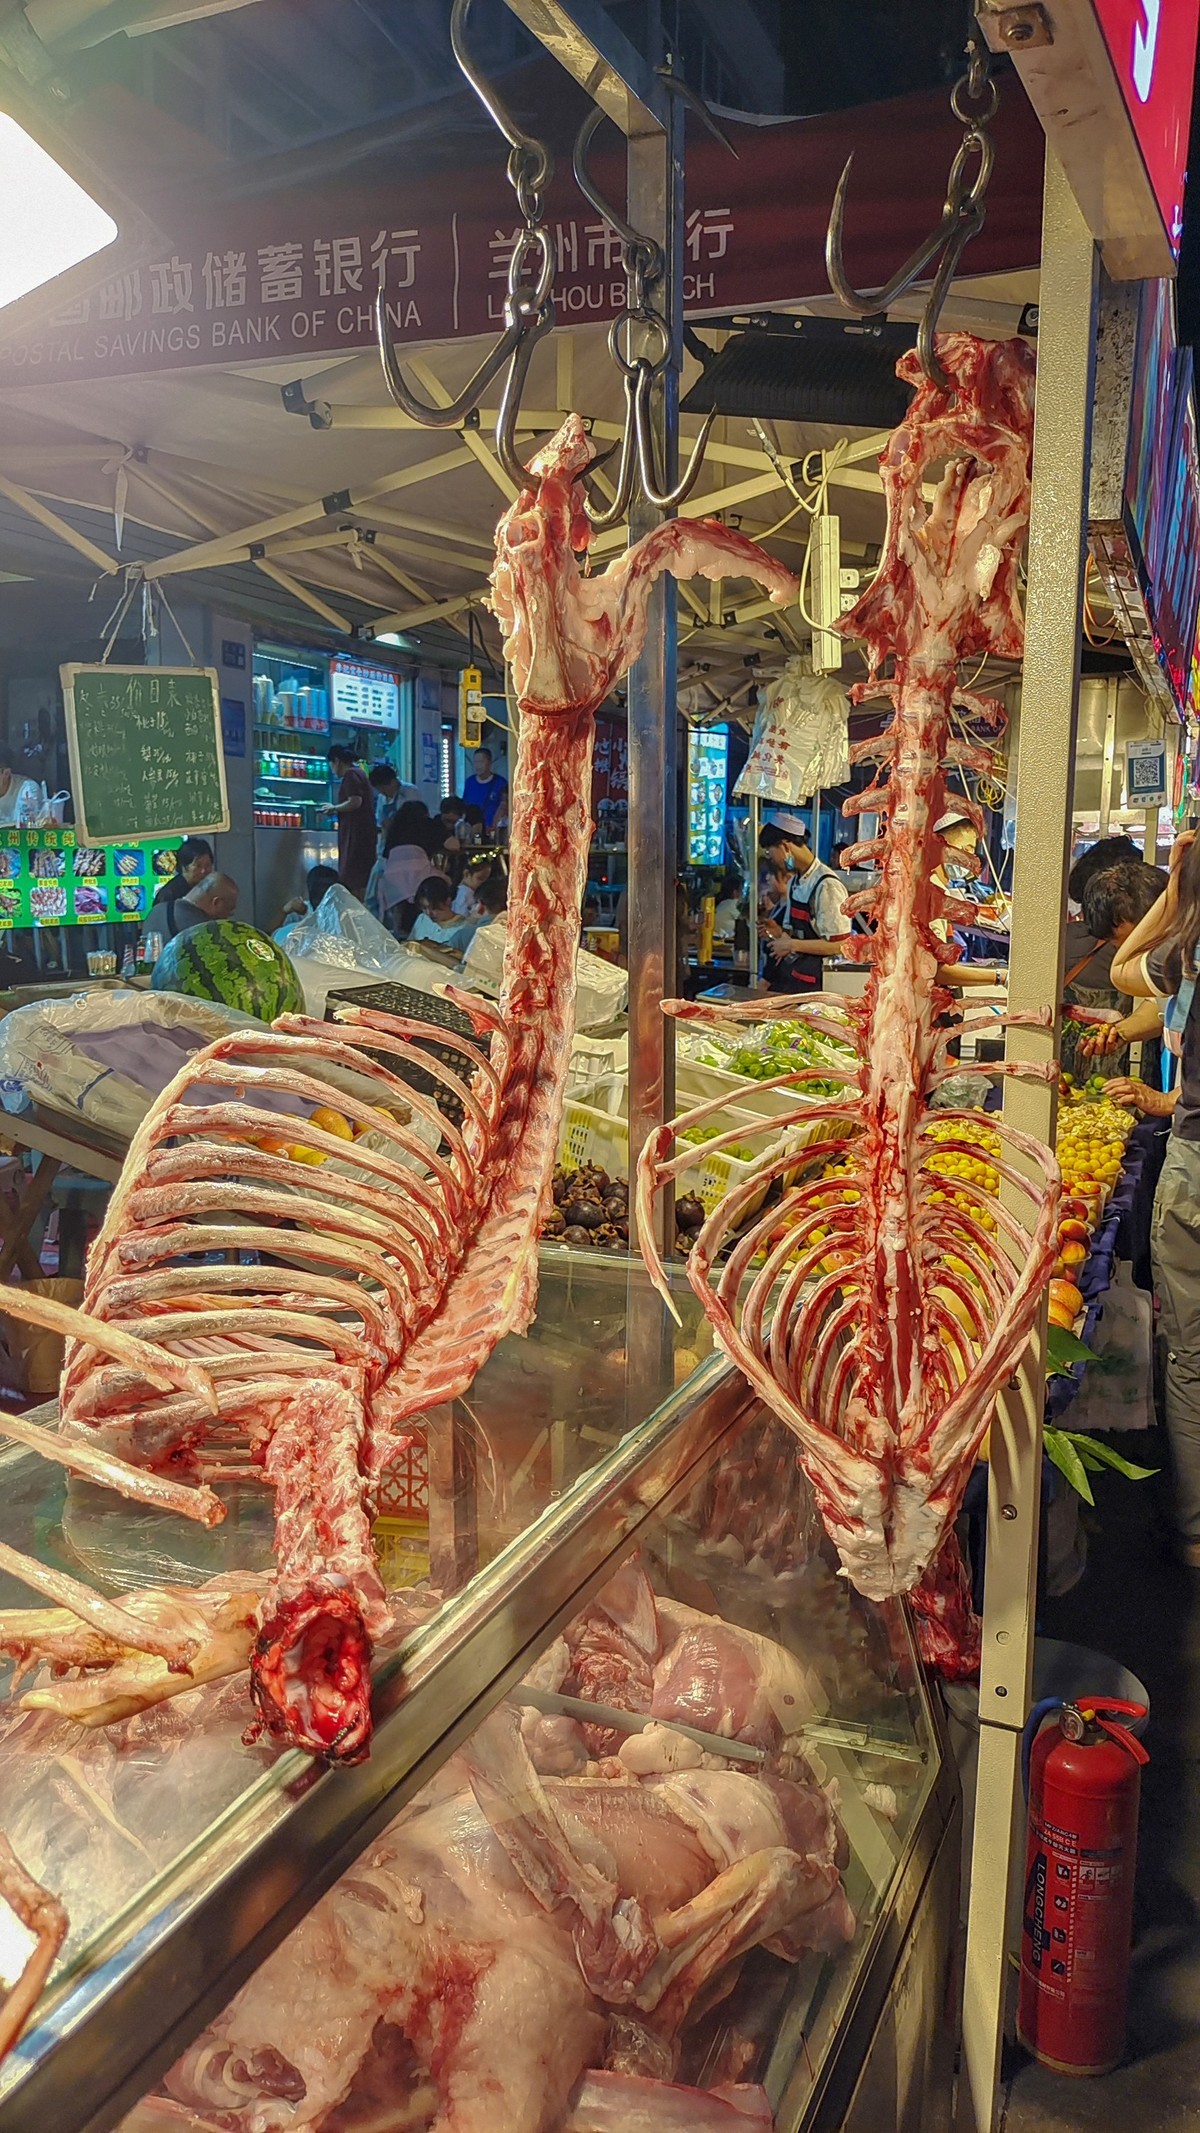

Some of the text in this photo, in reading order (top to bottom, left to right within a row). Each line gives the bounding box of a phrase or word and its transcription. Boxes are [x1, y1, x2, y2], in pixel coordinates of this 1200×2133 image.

[488, 207, 734, 279] 兰州市行
[487, 272, 715, 319] LHOU BCH
[94, 324, 201, 359] SAVINGS
[211, 314, 281, 347] BANK
[291, 309, 326, 338] OF
[336, 299, 422, 335] CHNA
[1032, 1861, 1046, 1962] LONGCHENG
